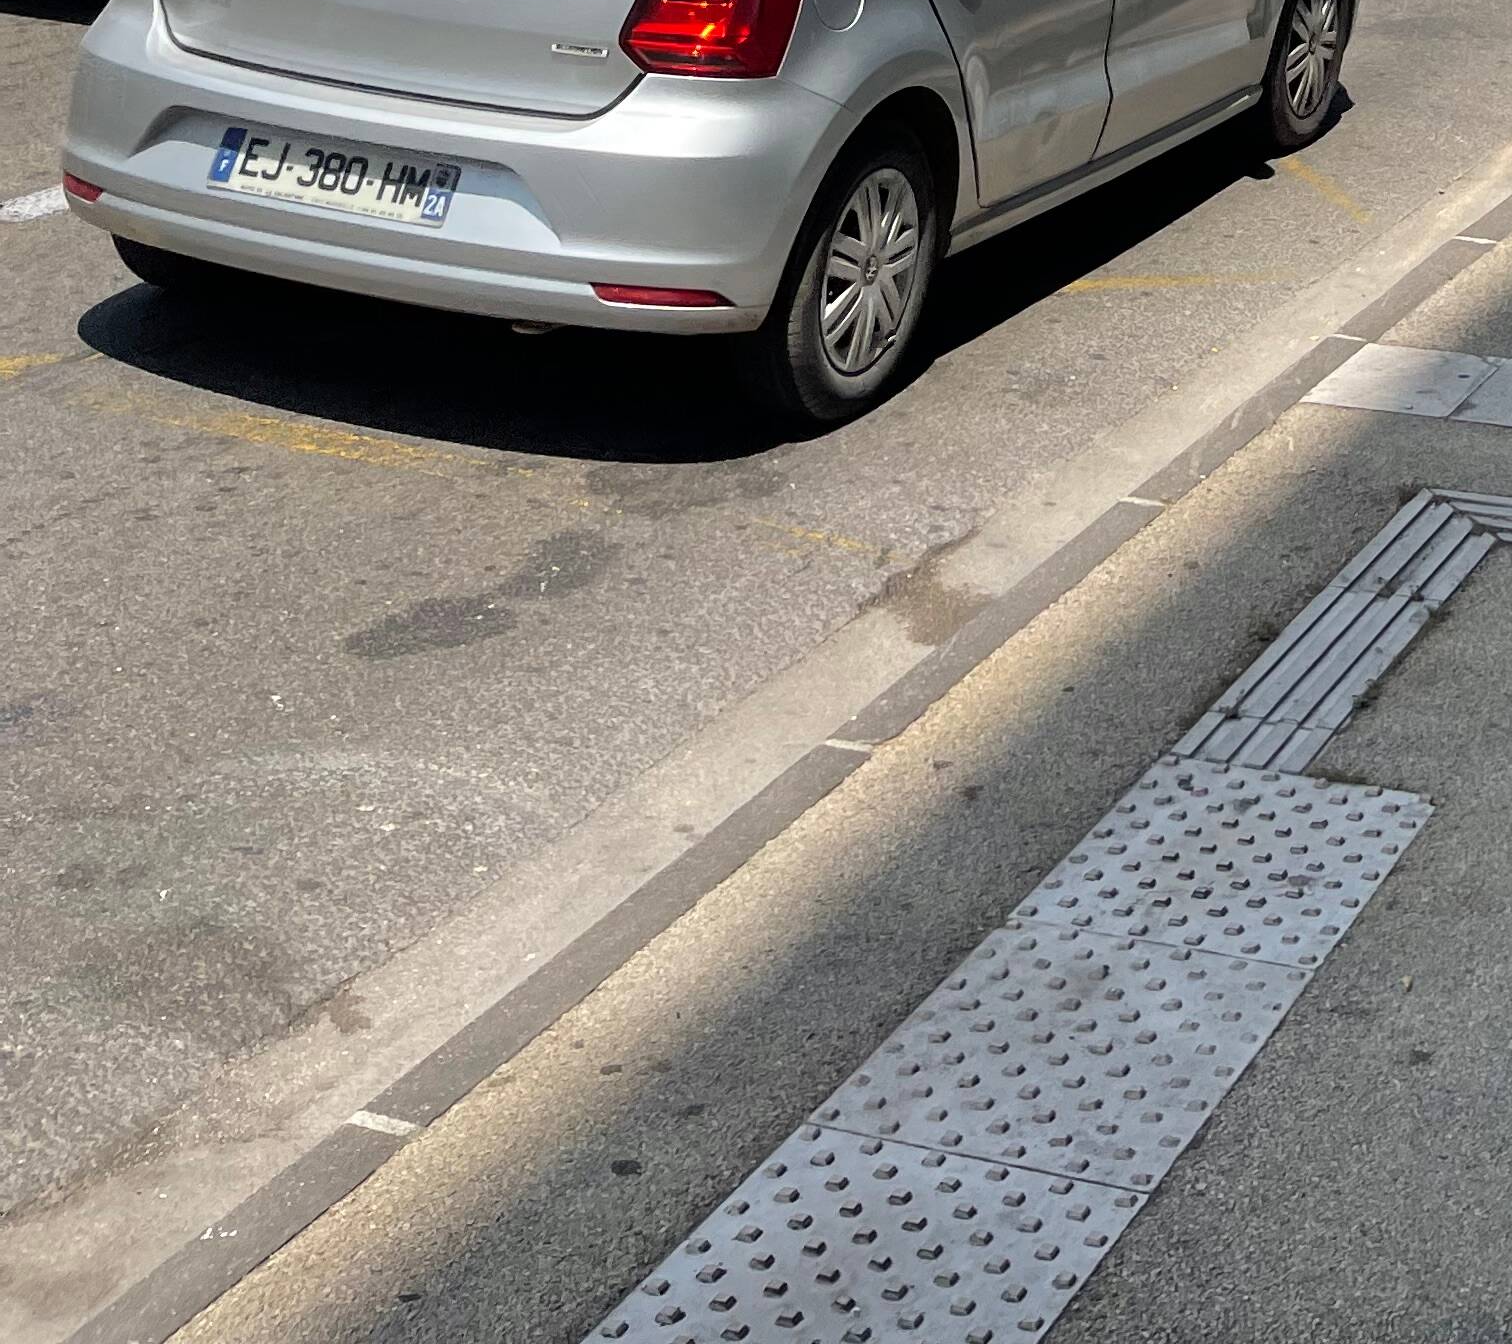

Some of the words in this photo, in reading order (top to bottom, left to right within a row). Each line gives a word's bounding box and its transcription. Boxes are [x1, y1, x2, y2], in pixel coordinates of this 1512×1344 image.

[218, 159, 230, 172] F
[238, 136, 432, 208] EJ-380-HM
[423, 189, 446, 218] 2A
